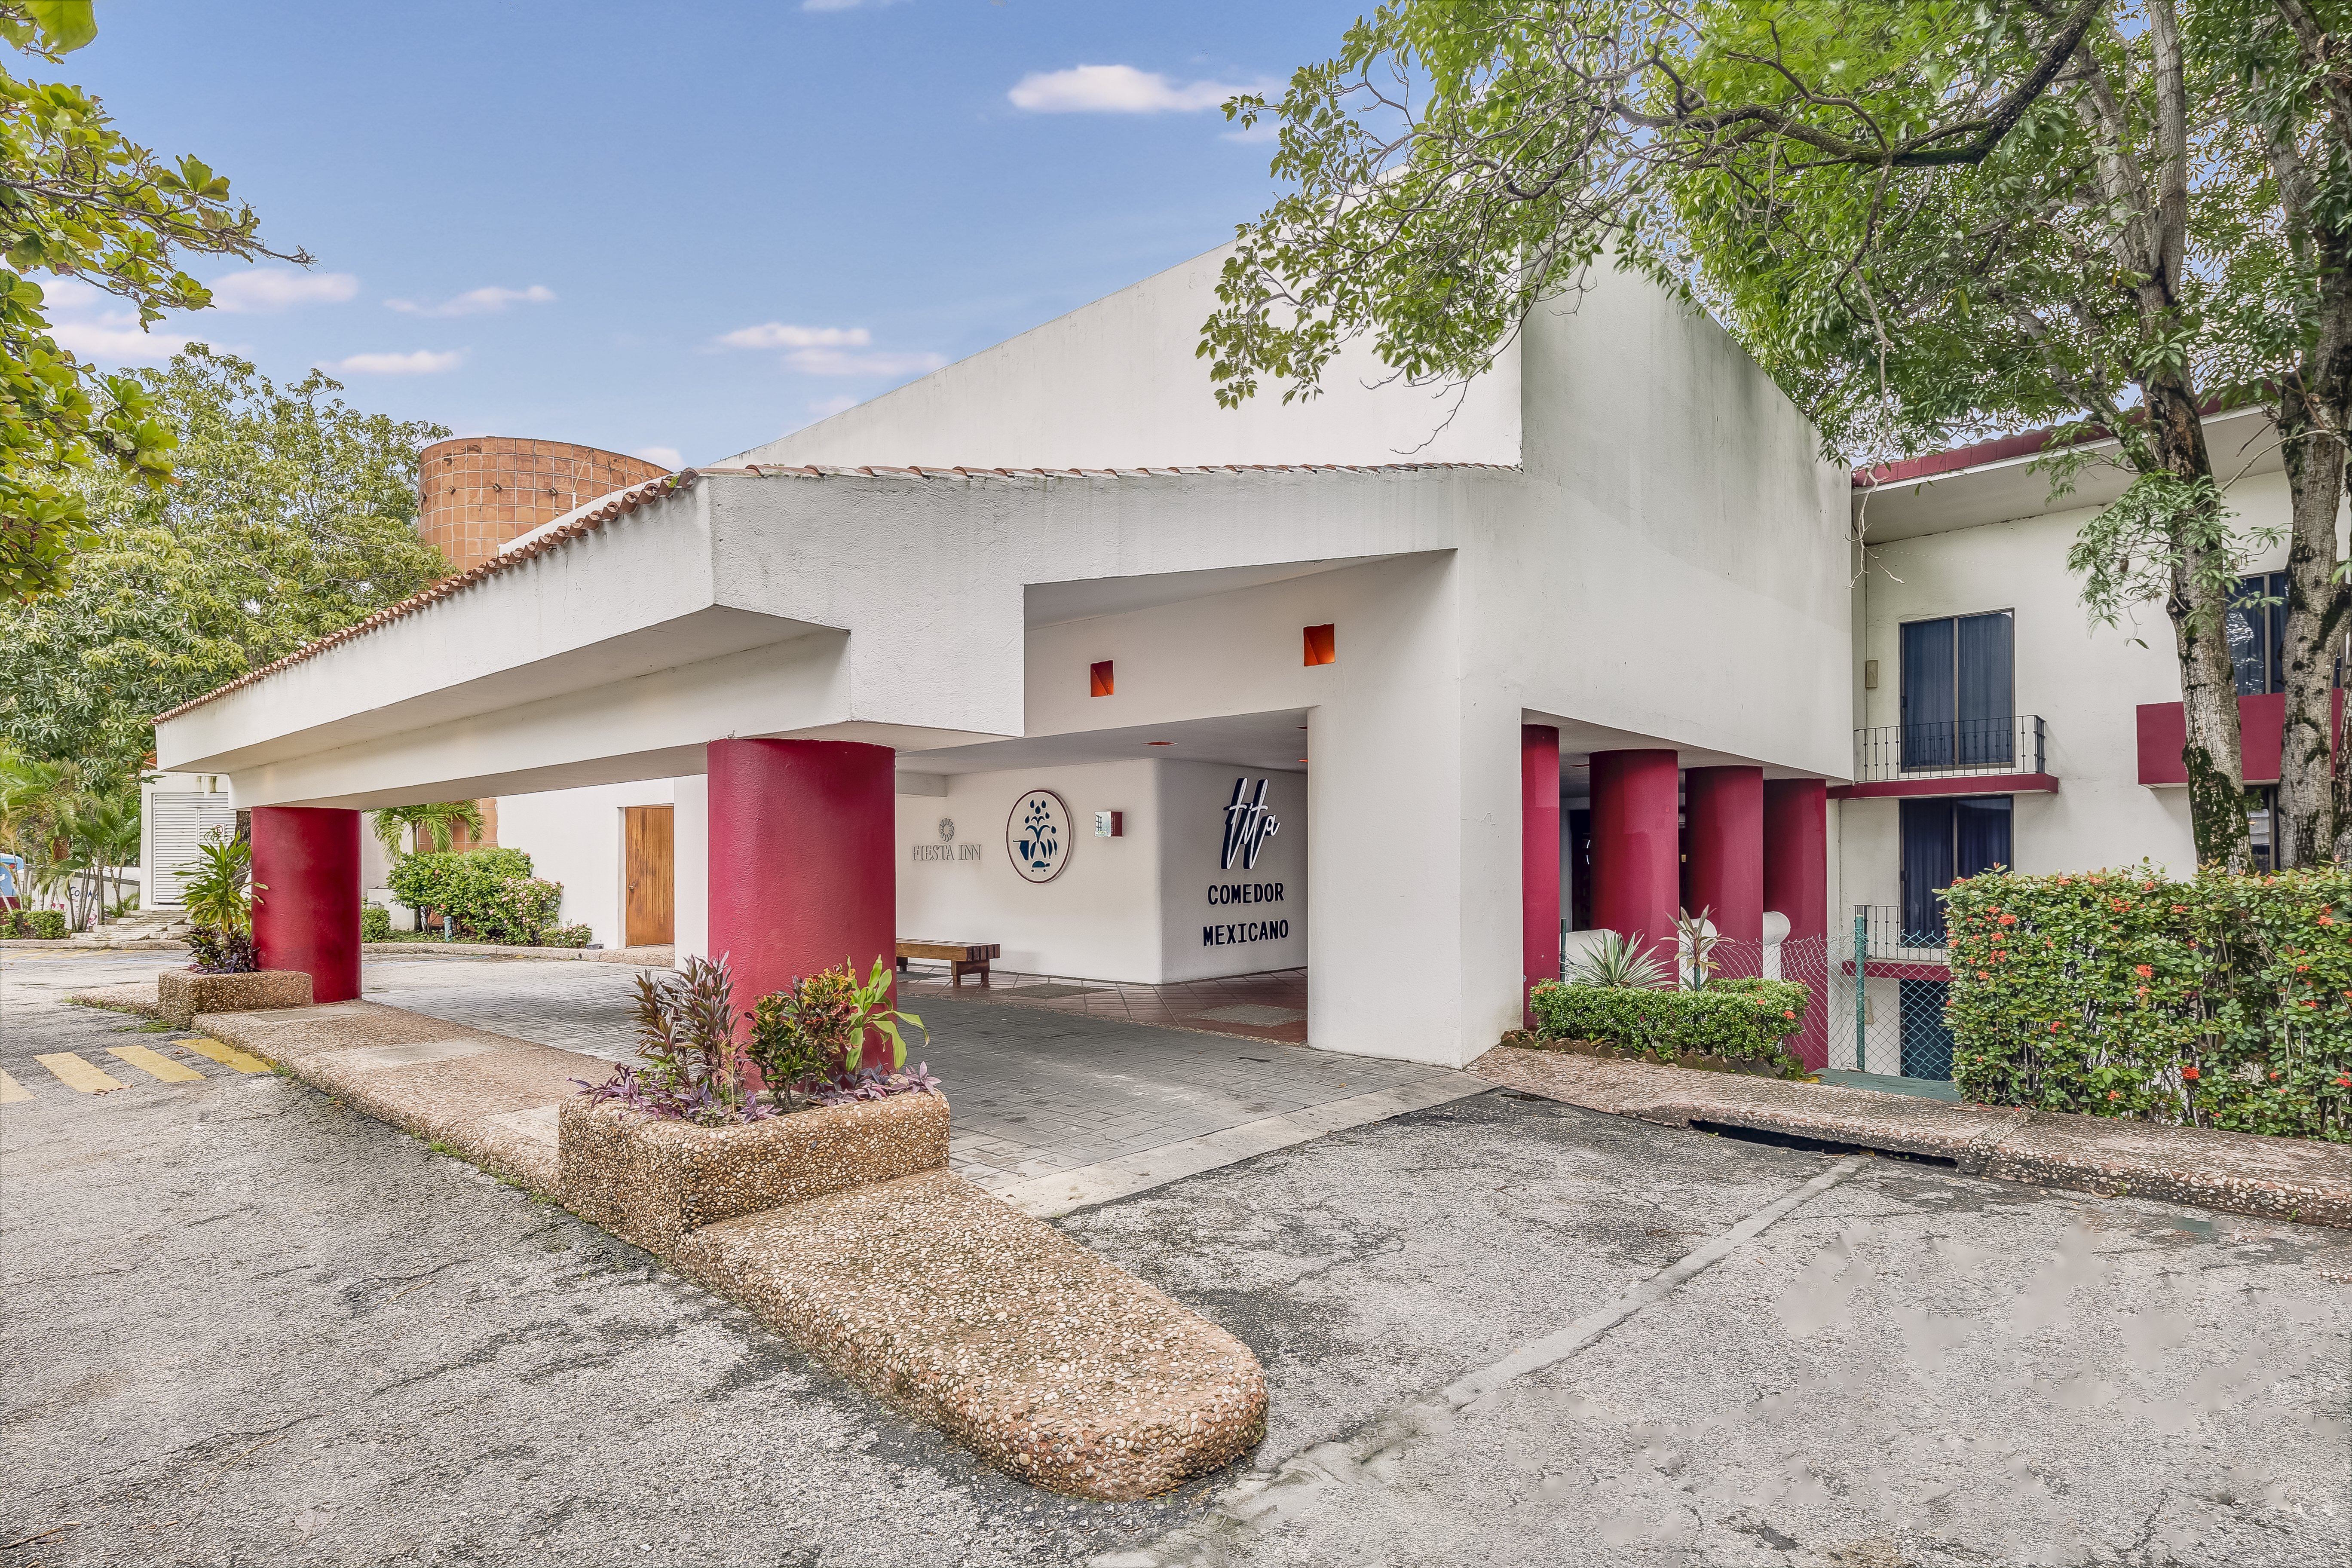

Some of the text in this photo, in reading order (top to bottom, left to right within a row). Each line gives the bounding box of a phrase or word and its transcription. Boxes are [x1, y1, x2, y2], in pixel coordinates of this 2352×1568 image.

[912, 844, 982, 861] FIESTA INN
[1207, 882, 1284, 905] COMEDOR
[1203, 919, 1289, 946] MEXICANO
